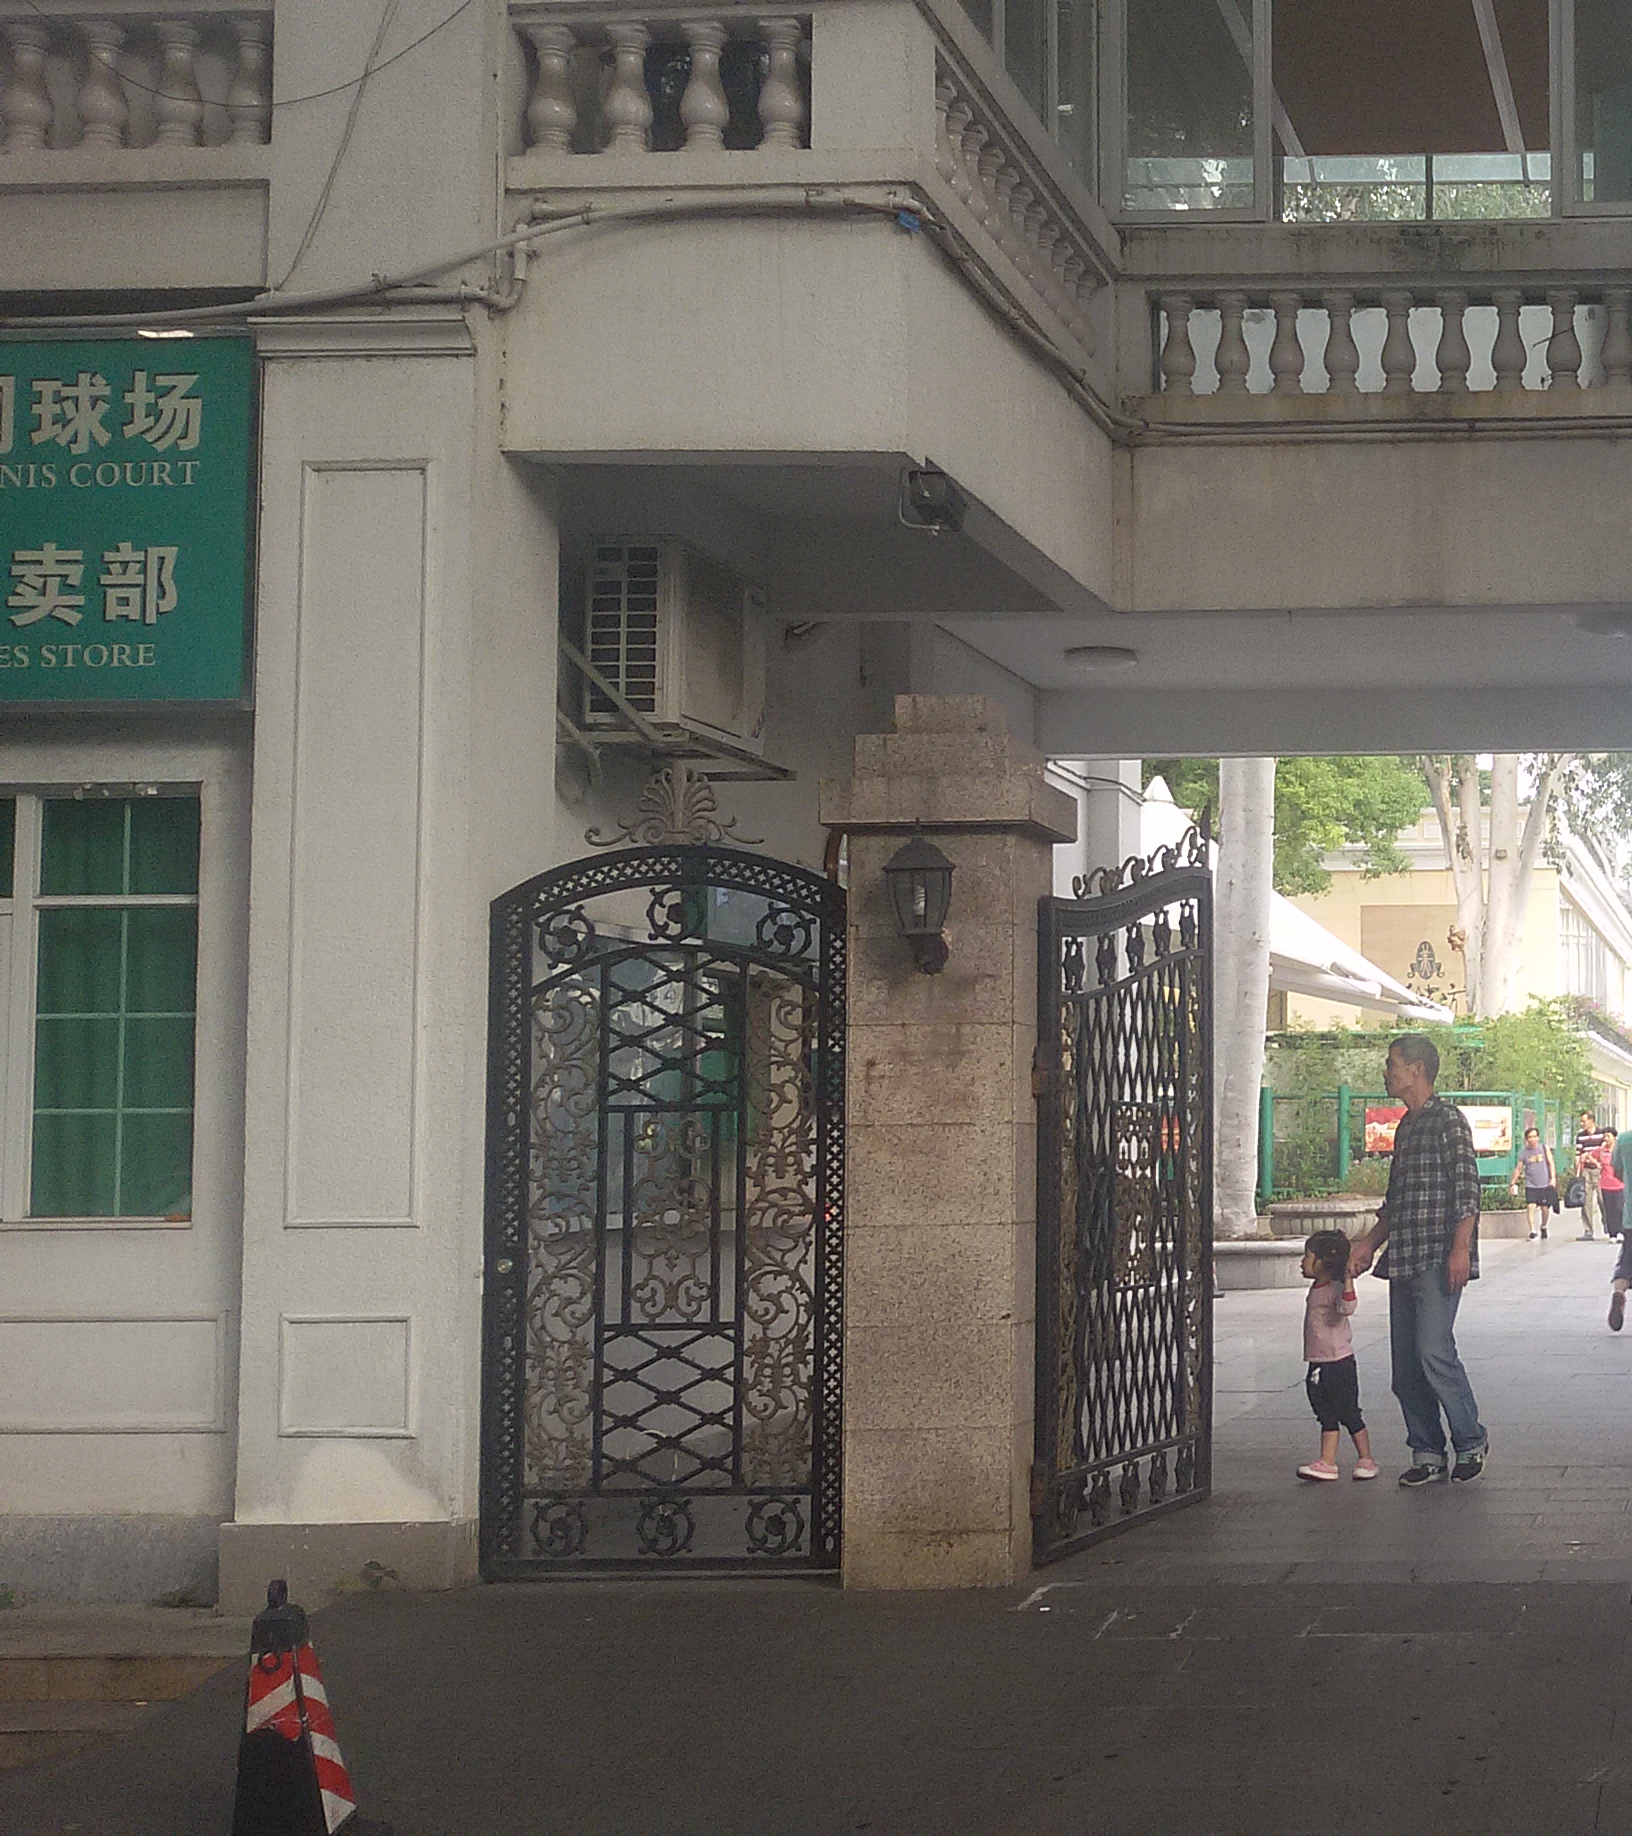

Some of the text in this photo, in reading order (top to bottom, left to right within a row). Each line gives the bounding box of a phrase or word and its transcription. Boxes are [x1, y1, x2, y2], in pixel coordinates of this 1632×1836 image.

[0, 369, 203, 454] 球场
[70, 460, 200, 488] COURT
[6, 541, 179, 627] 卖部
[40, 643, 156, 668] STORE
